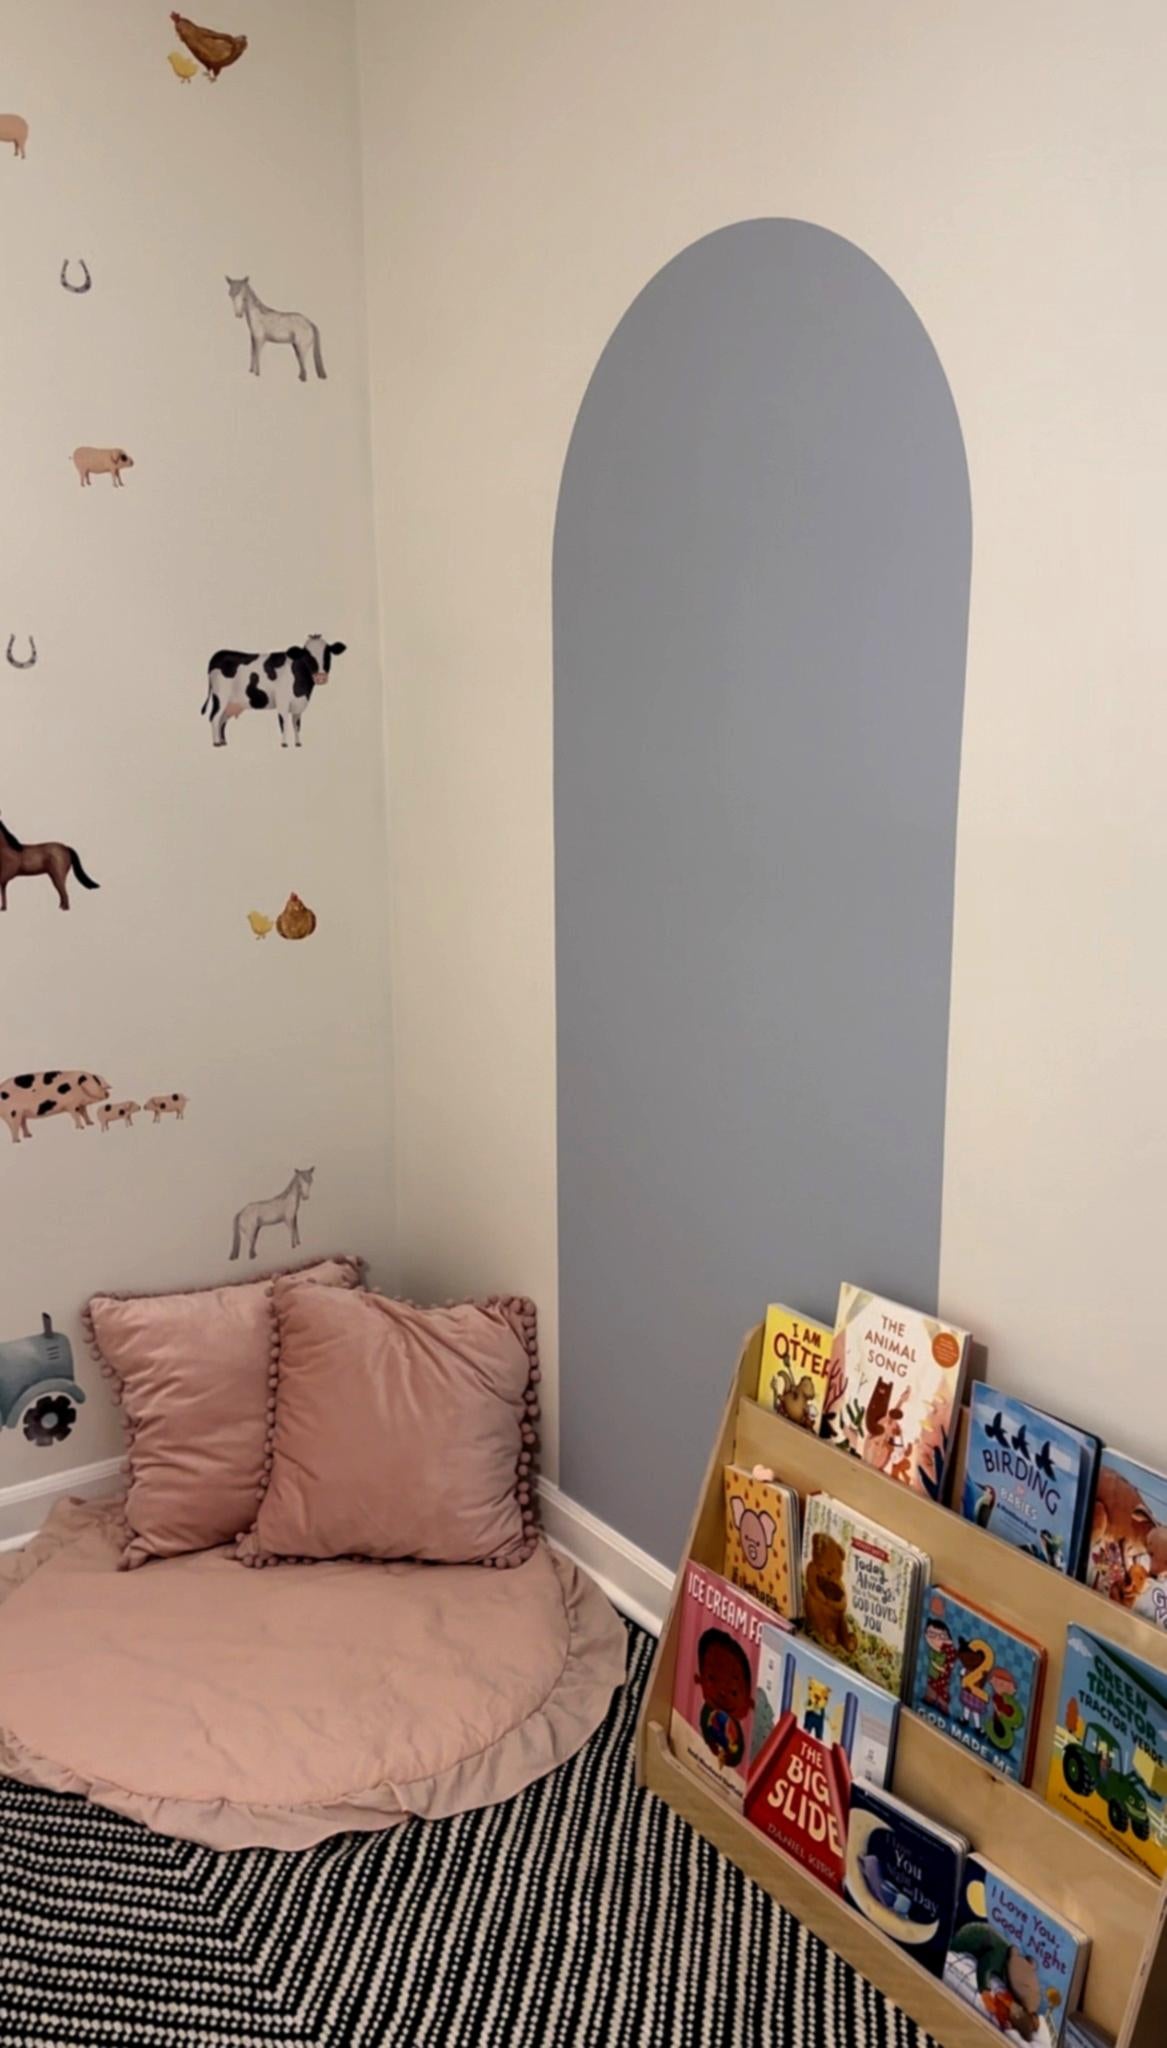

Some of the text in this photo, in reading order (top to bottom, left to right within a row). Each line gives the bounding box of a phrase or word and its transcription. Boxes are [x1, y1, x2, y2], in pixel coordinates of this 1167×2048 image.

[792, 1322, 821, 1348] I AM
[881, 1315, 906, 1337] THE
[864, 1329, 917, 1363] ANIMAL
[868, 1349, 908, 1378] SONG
[982, 1449, 1061, 1516] BIRDING
[1000, 1487, 1038, 1521] BABIES
[688, 1571, 706, 1604] ICE
[705, 1585, 747, 1635] CREAM
[870, 1602, 897, 1624] LOVES
[864, 1614, 882, 1632] YOU
[961, 1639, 995, 1702] 2
[1094, 1655, 1148, 1715] GREEN
[1078, 1689, 1128, 1737] TRACTOR
[1087, 1670, 1157, 1746] TRACTOR
[801, 1741, 823, 1769] THE
[916, 1708, 1015, 1777] GOD MADE ME
[787, 1753, 831, 1807] BIG
[767, 1778, 844, 1858] SLIDE
[767, 1823, 806, 1859] DANIEL
[895, 1849, 922, 1880] You
[913, 1887, 939, 1917] Day
[992, 1885, 997, 1898] I
[999, 1890, 1028, 1922] Love
[992, 1907, 1066, 1975] Good Night
